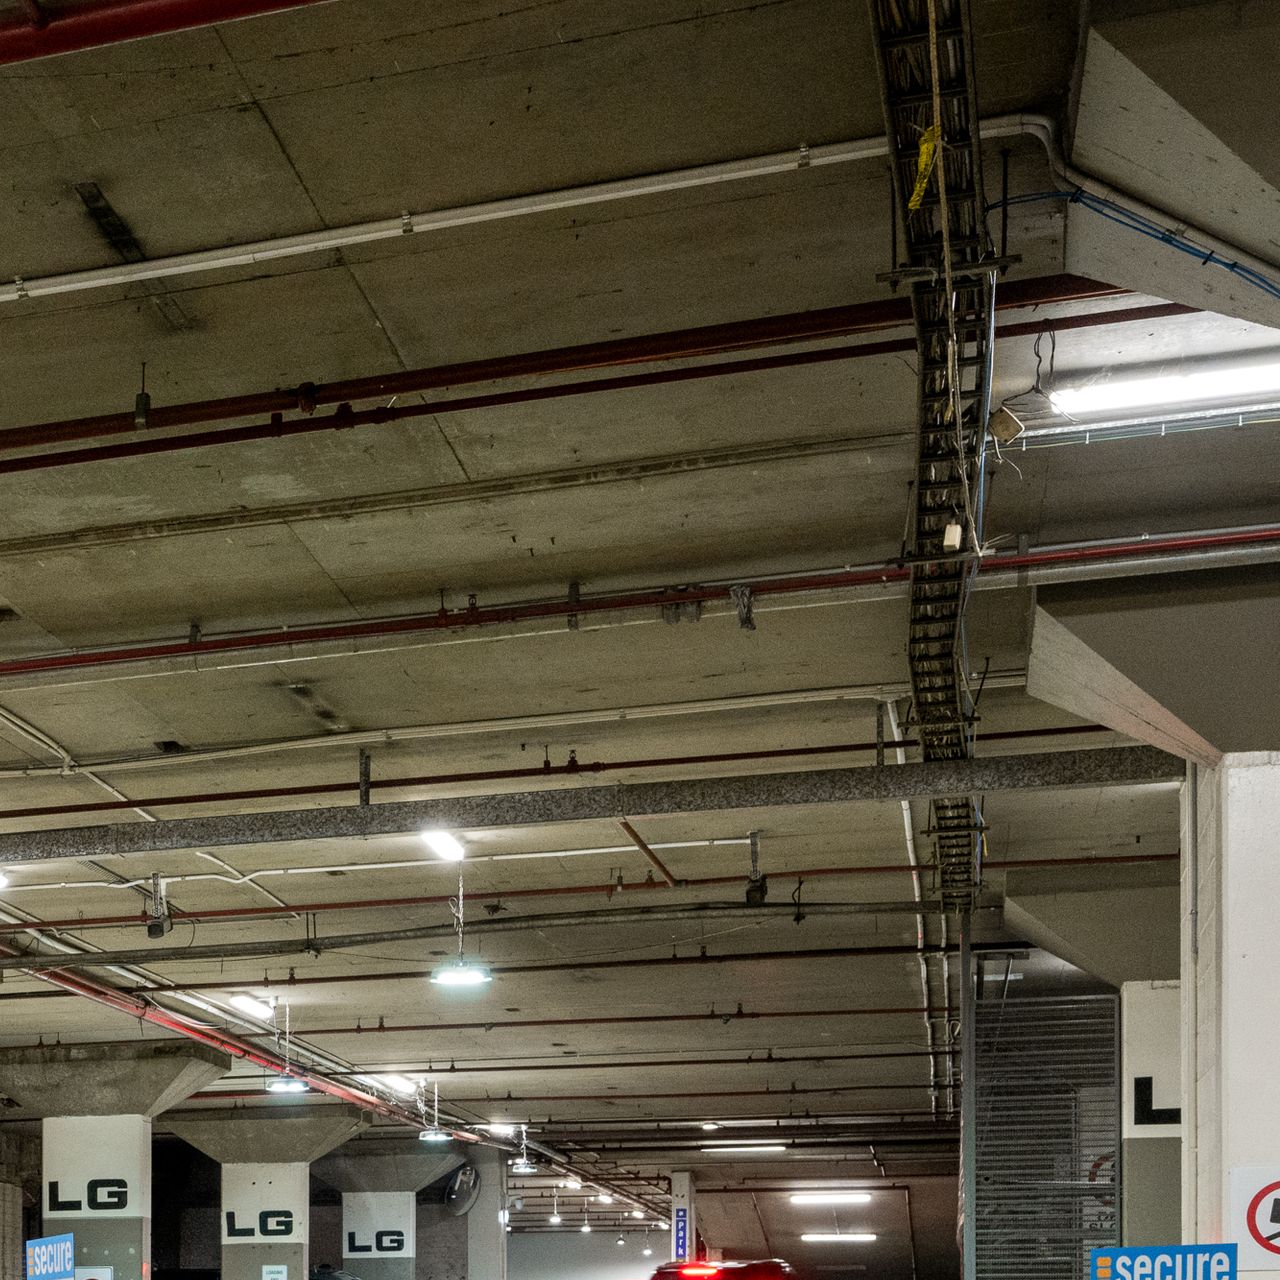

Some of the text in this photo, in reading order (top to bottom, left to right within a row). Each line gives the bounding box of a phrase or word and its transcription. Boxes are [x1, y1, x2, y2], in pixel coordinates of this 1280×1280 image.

[48, 1179, 128, 1212] LG
[226, 1210, 293, 1237] LG
[348, 1230, 404, 1252] LG
[34, 1241, 72, 1275] secure
